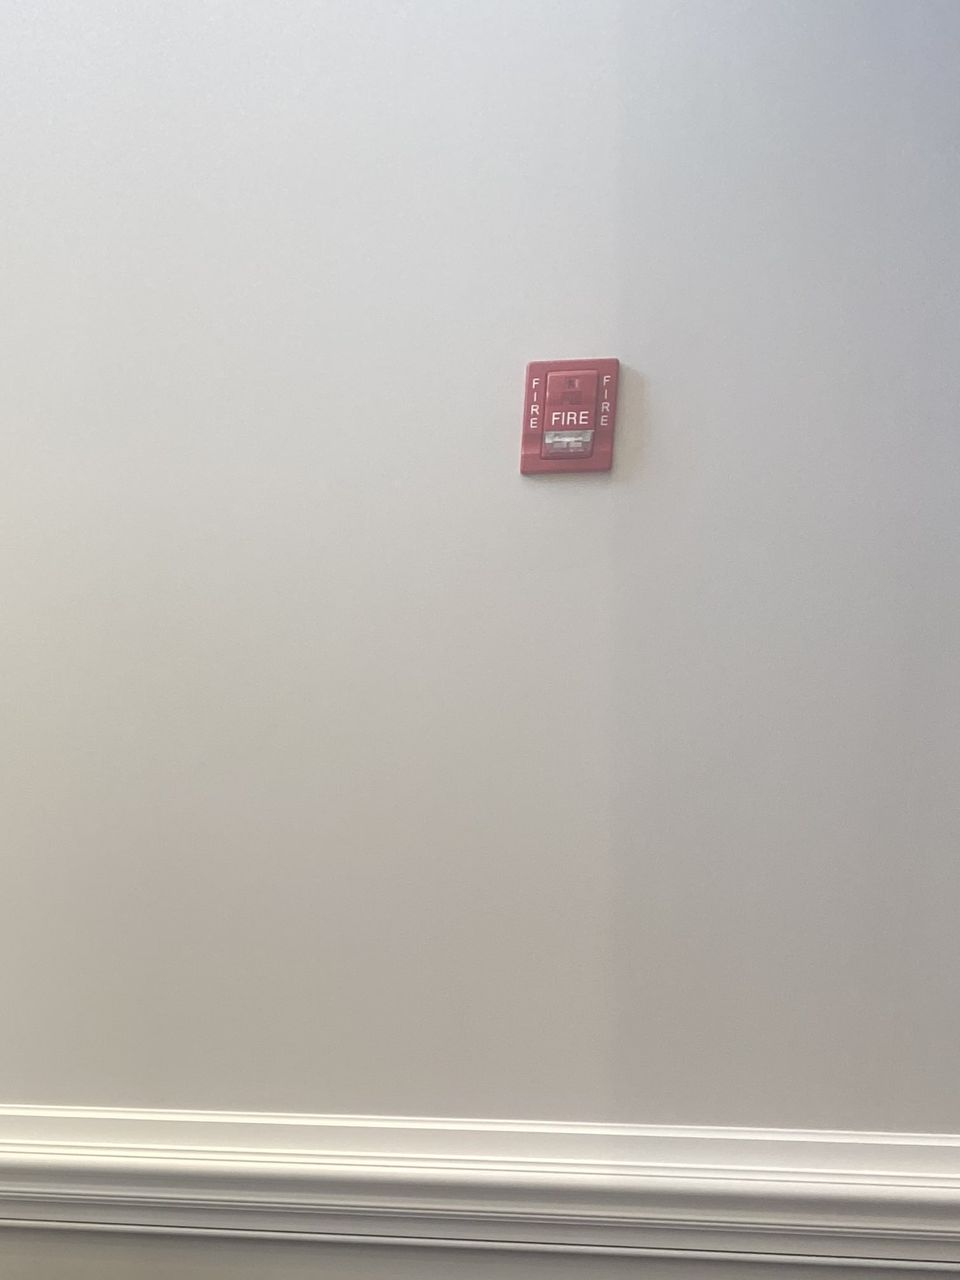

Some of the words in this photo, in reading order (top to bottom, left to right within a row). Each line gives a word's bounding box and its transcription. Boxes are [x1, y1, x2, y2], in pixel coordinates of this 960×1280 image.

[530, 378, 540, 429] FIRE
[551, 411, 590, 426] FIRE
[600, 375, 611, 426] FIRE
